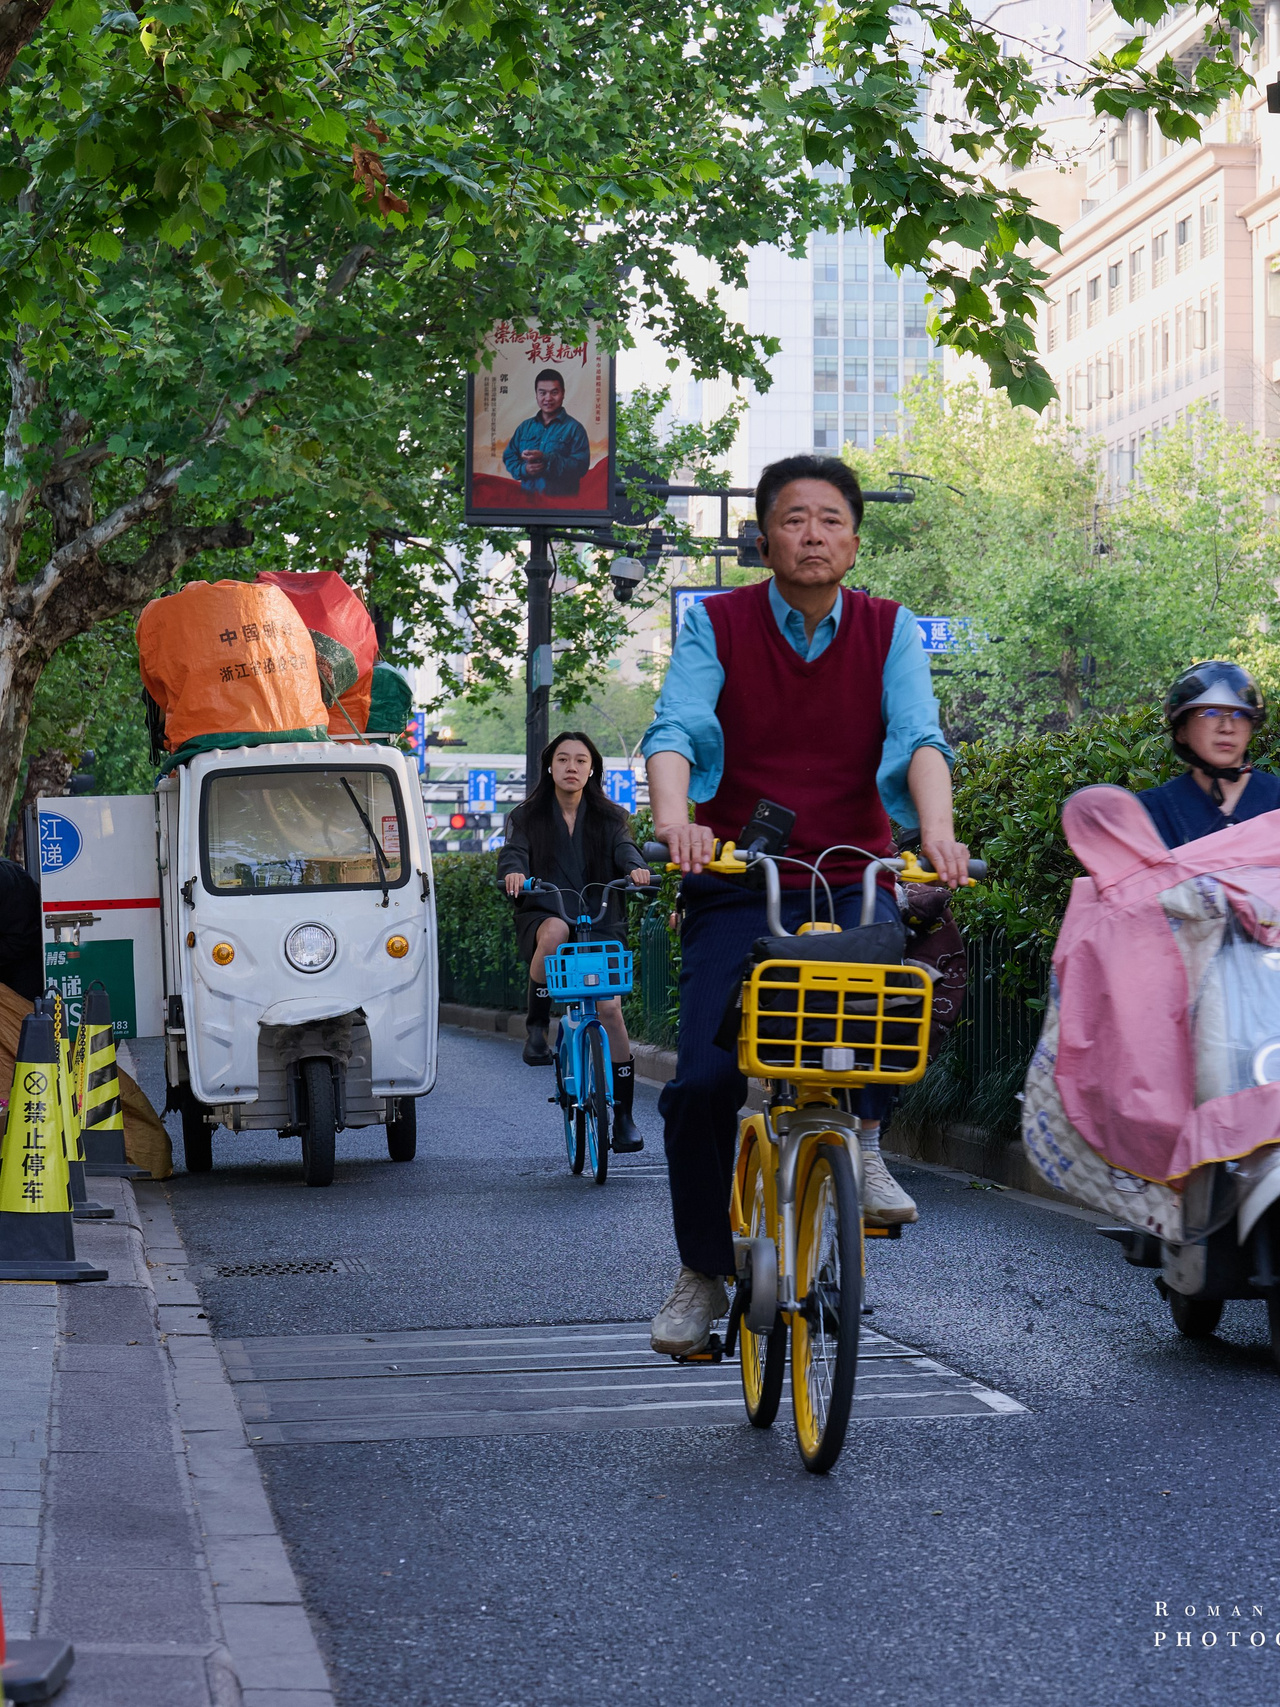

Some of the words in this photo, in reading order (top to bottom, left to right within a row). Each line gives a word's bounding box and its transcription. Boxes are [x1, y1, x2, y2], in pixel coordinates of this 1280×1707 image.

[525, 341, 588, 368] 最美杭州
[219, 621, 295, 647] 中国邮政
[41, 819, 63, 840] 江
[41, 843, 64, 866] 递
[45, 951, 66, 966] MS
[21, 1100, 47, 1204] 禁止停车
